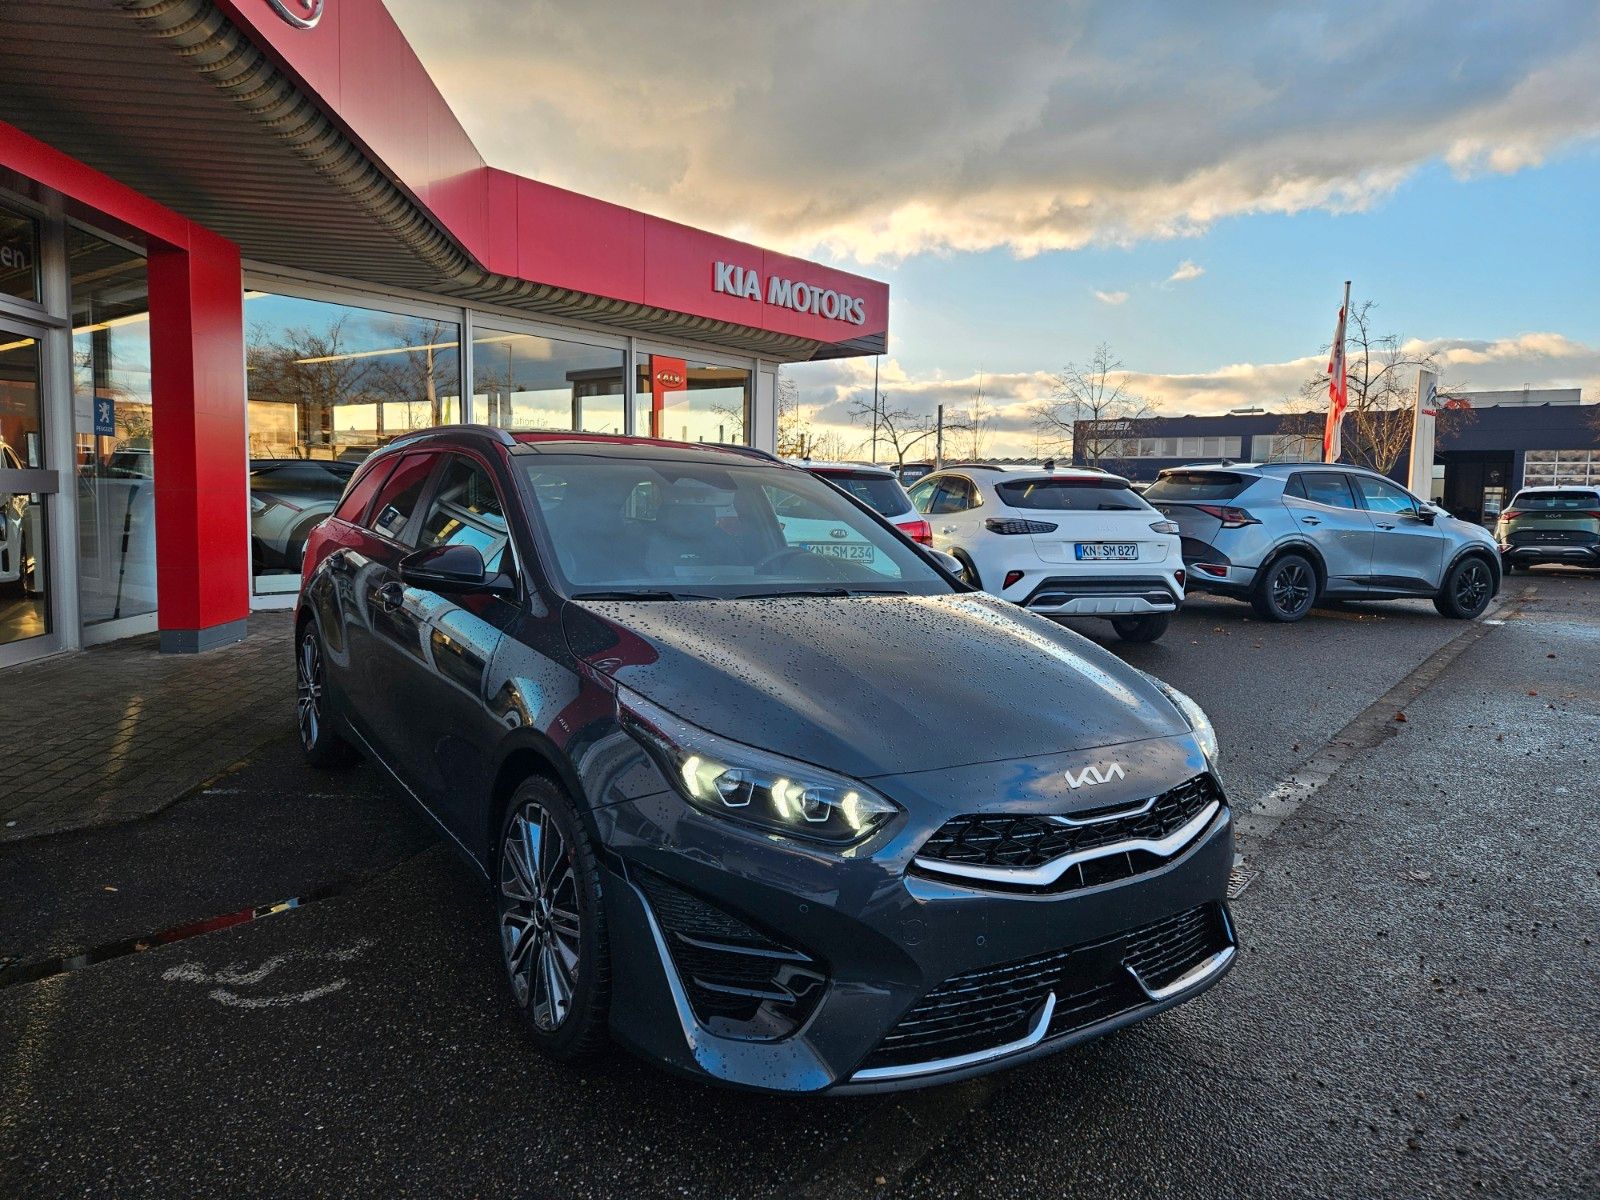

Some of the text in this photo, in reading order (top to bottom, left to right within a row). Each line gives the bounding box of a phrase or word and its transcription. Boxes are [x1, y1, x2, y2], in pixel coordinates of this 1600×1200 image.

[713, 261, 866, 326] KIA MOTORS
[832, 546, 848, 559] SM
[850, 546, 872, 559] 234
[1082, 545, 1136, 557] KN SM 827
[1064, 762, 1126, 789] KIA
